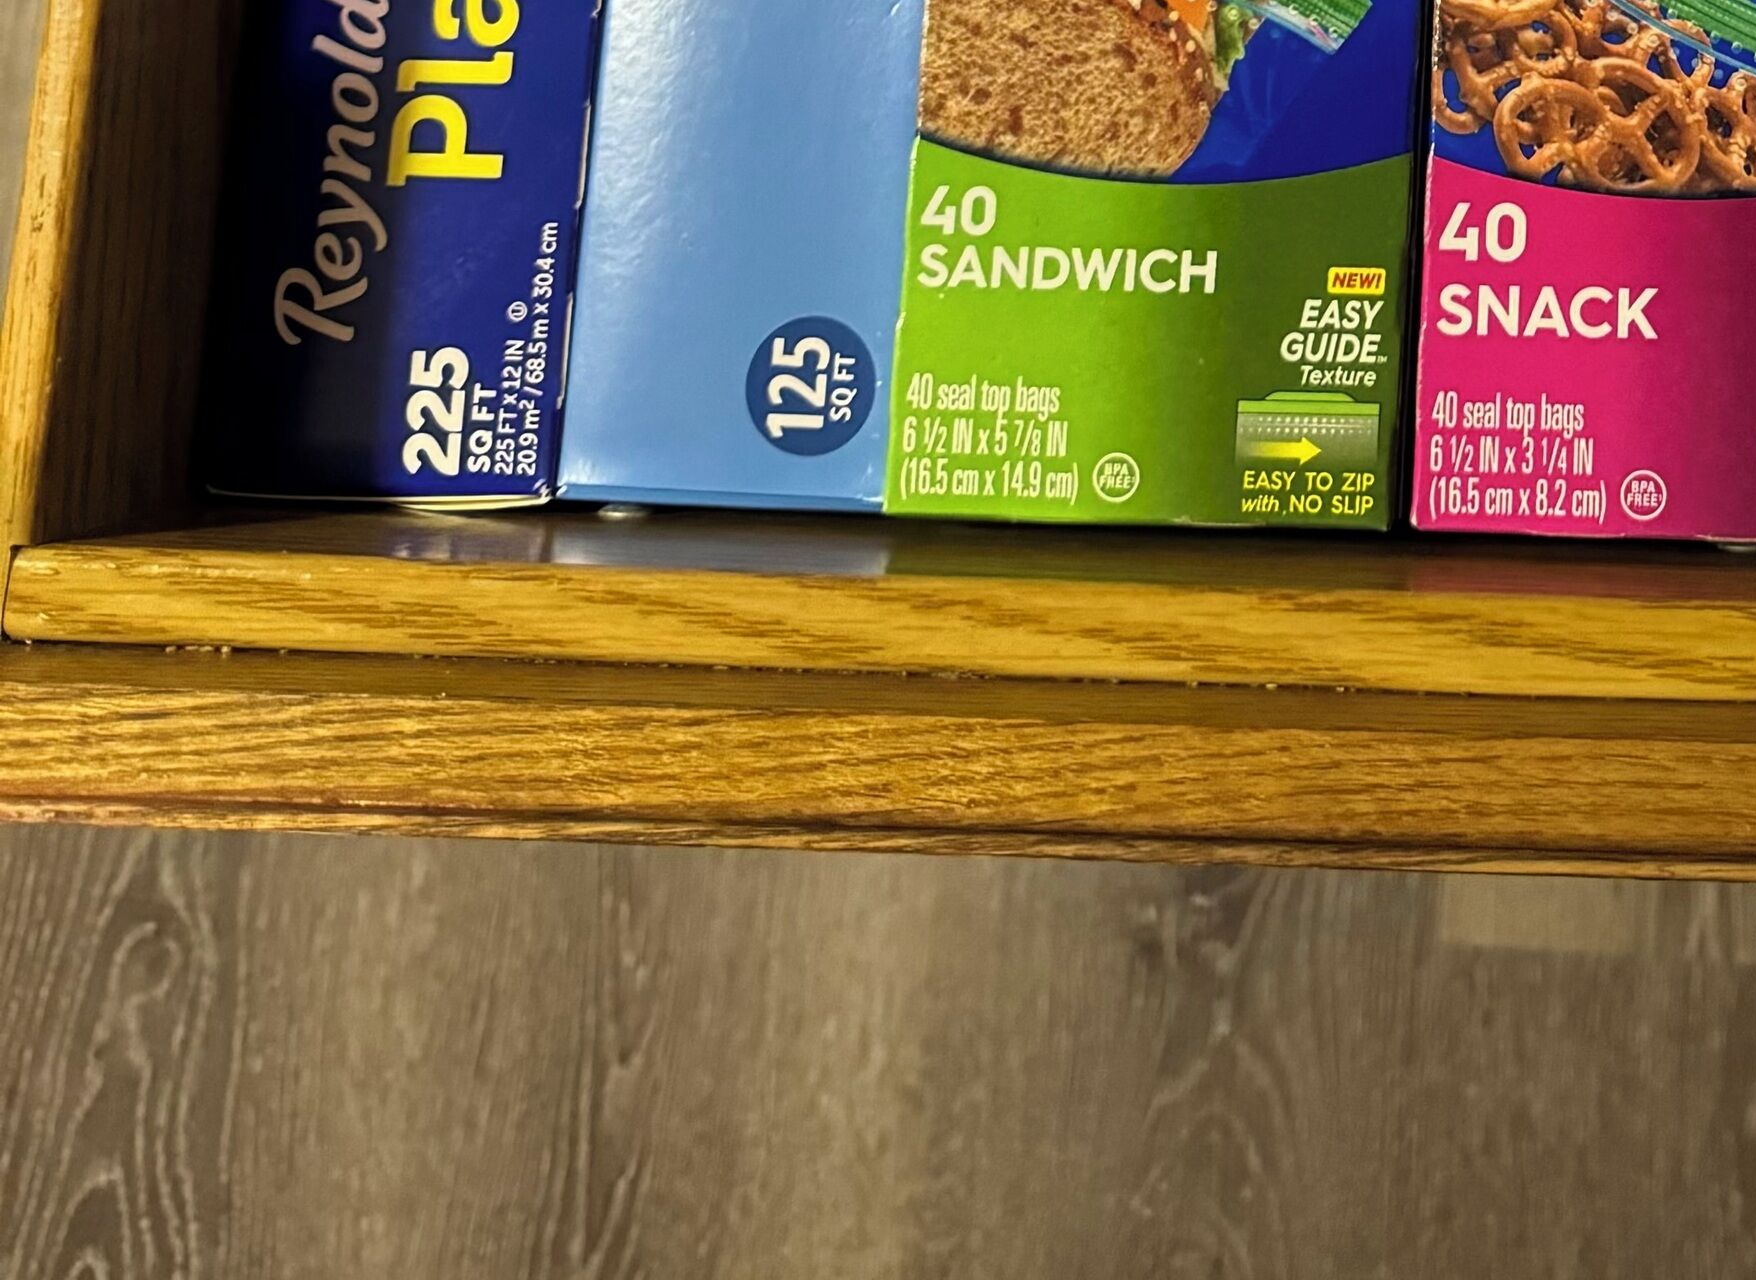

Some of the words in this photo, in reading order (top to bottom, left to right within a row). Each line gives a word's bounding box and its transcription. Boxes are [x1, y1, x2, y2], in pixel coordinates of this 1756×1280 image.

[920, 185, 997, 236] 40
[1438, 202, 1527, 263] 40
[532, 258, 556, 299] 30.4
[917, 244, 1218, 294] SANDWICH
[1332, 272, 1382, 289] NEW!
[1300, 299, 1384, 329] EASY
[1436, 283, 1659, 340] SNACK
[502, 364, 522, 389] 12
[525, 341, 548, 385] 68.5
[832, 352, 856, 382] FT
[1301, 365, 1377, 387] Texture
[471, 382, 497, 421] FT
[766, 336, 831, 438] 125
[829, 387, 858, 423] SQ
[906, 372, 934, 409] 40
[936, 374, 977, 410] seal
[981, 380, 1011, 417] top
[1015, 376, 1060, 422] bags
[402, 345, 470, 477] 225
[1432, 390, 1458, 429] 40
[1463, 392, 1501, 429] seal
[1506, 396, 1535, 436] top
[1540, 393, 1585, 439] bags
[466, 429, 494, 473] SQ
[494, 439, 515, 475] 225
[517, 435, 538, 476] 20.9
[900, 457, 949, 500] (16.5
[1002, 460, 1042, 498] 14.9
[1046, 462, 1079, 506] cm)
[1243, 470, 1295, 490] EASY
[1305, 471, 1333, 491] TO
[1342, 473, 1375, 492] ZIP
[1429, 476, 1480, 522] (16.5
[1535, 479, 1566, 517] 8.2
[1572, 480, 1607, 525] cm)
[1241, 494, 1280, 513] with
[1289, 494, 1323, 513] NO
[1331, 495, 1374, 515] SLIP
